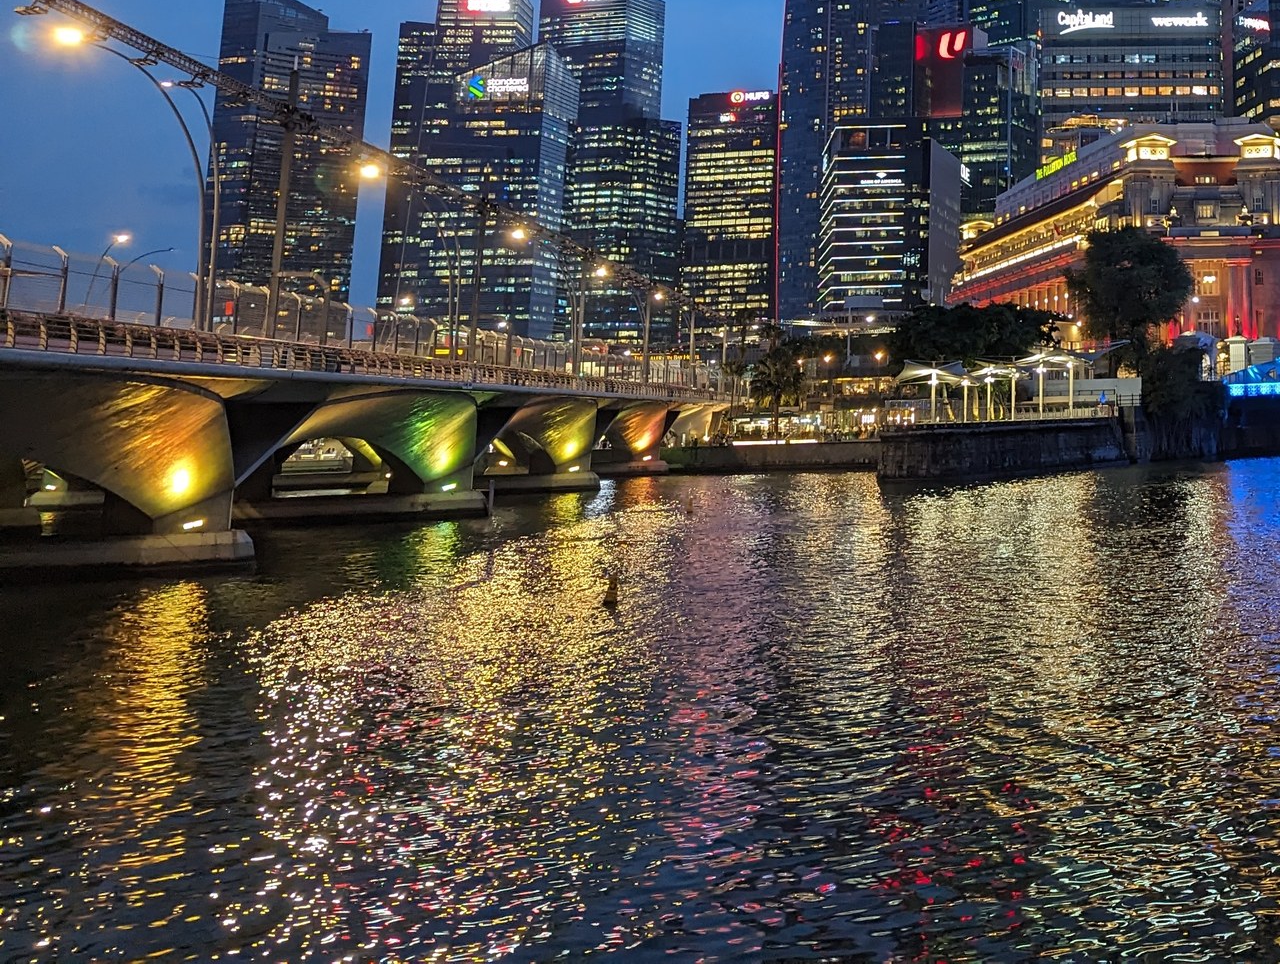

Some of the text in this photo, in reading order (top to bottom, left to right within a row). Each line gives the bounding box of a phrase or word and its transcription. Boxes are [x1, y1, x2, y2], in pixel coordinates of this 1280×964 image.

[1058, 9, 1113, 28] CapitaLand
[487, 77, 528, 86] standard
[487, 84, 529, 92] chartered
[745, 91, 770, 101] MUFG
